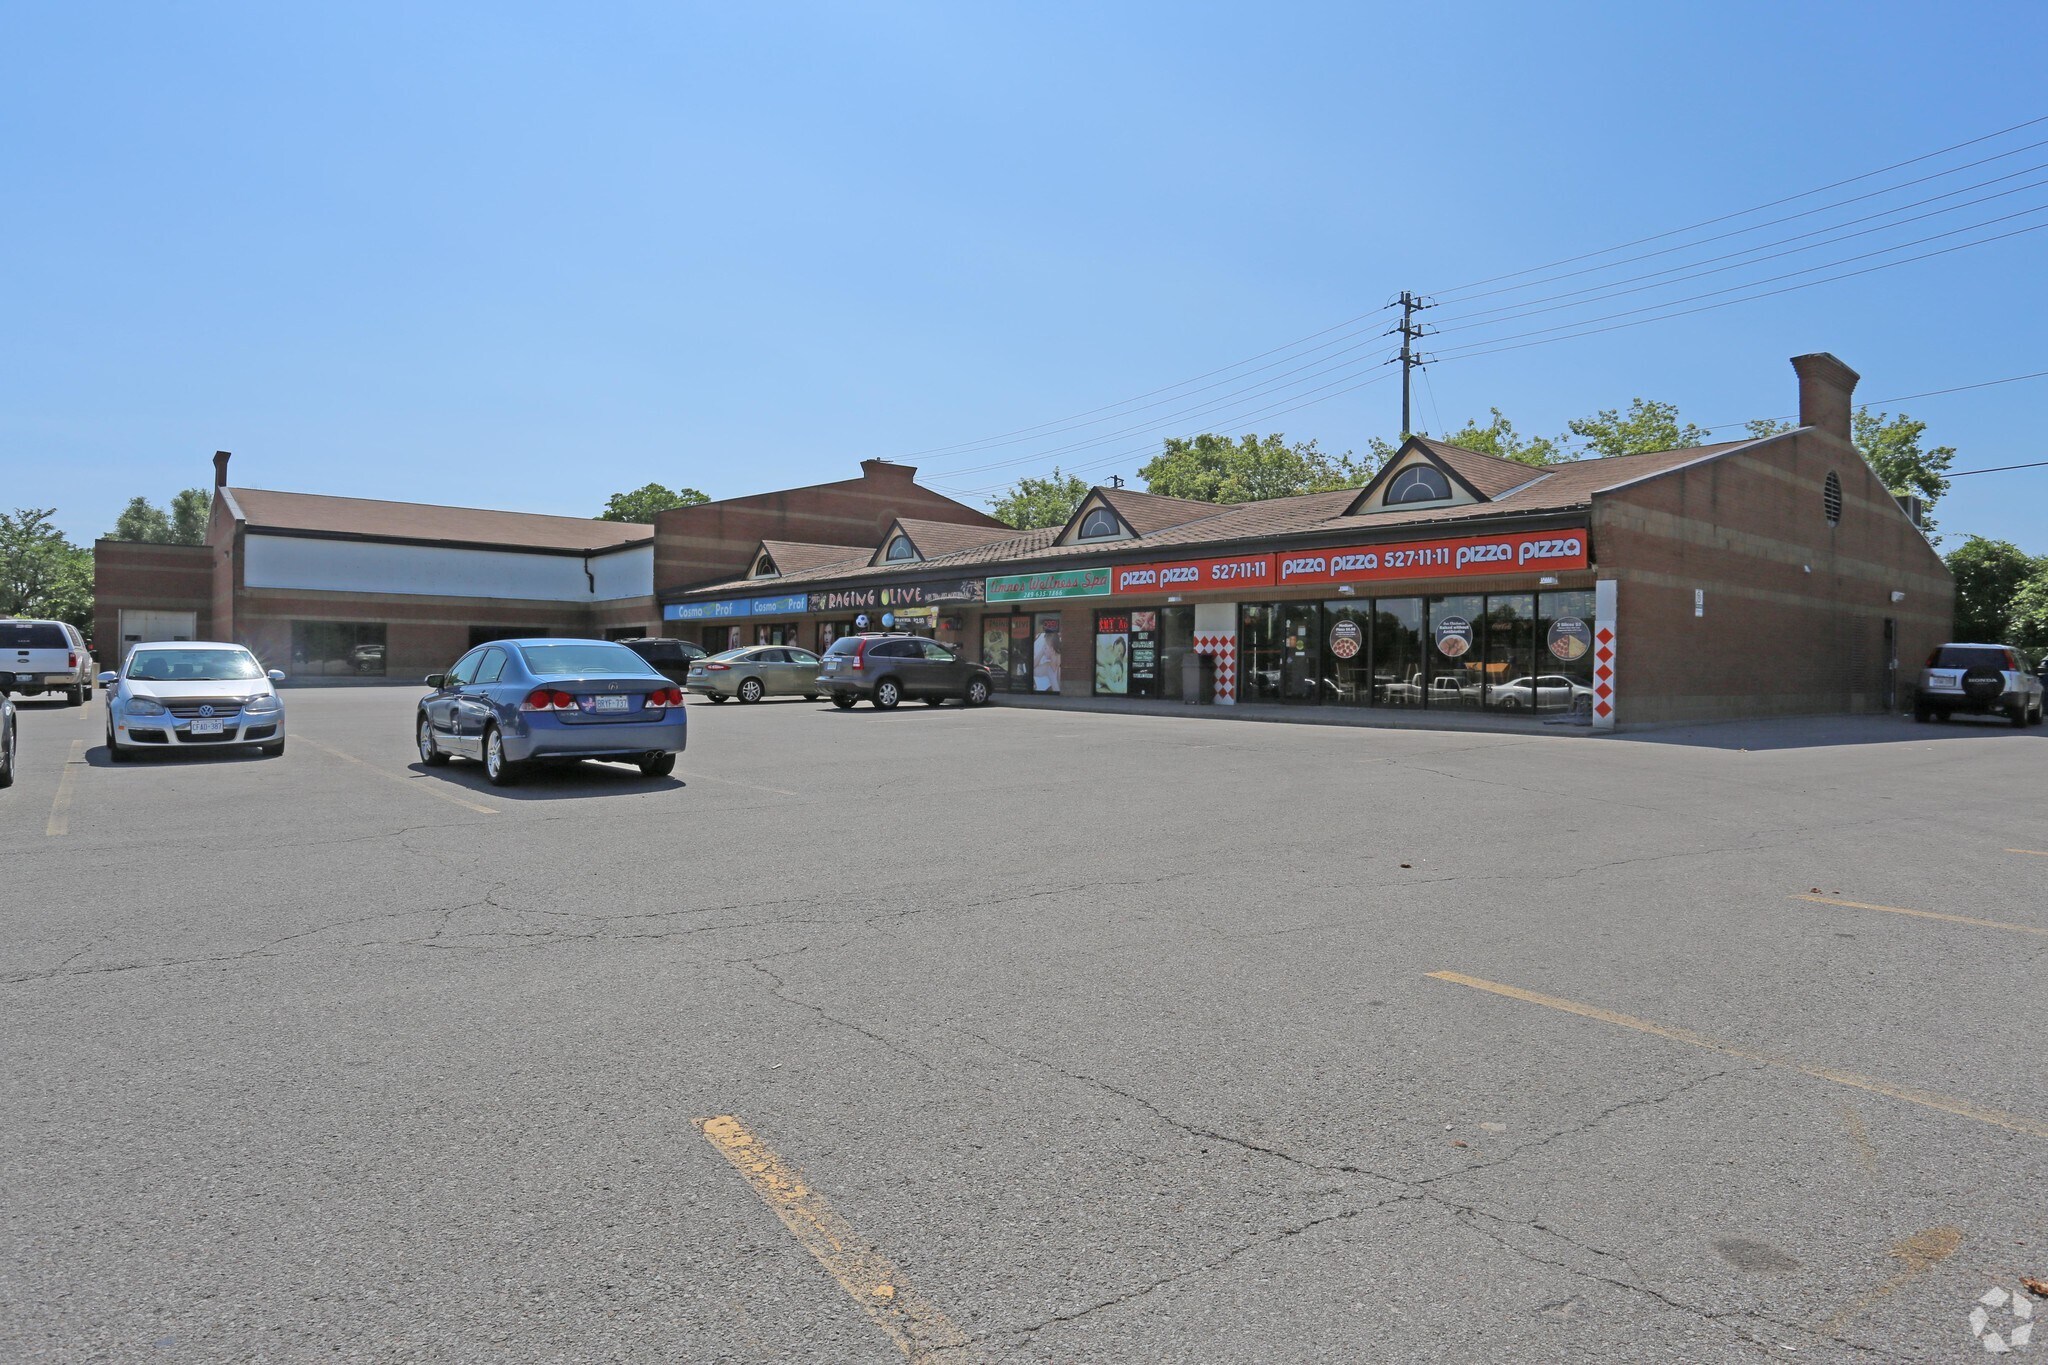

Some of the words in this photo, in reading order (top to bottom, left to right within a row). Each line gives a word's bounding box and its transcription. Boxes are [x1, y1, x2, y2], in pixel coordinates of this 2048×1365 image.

[1282, 557, 1326, 580] pizza
[1330, 553, 1378, 577] pizza
[1455, 543, 1512, 570] pizza
[1518, 538, 1581, 566] pizza
[1029, 575, 1078, 591] Wellness
[1081, 572, 1108, 590] Spa
[1120, 569, 1156, 591] pizza
[1159, 566, 1199, 588] pizza
[754, 600, 777, 612] Cosmo
[788, 597, 805, 610] Prof
[828, 589, 875, 609] RAGING
[678, 605, 703, 617] Cosmo
[715, 602, 733, 616] Prof
